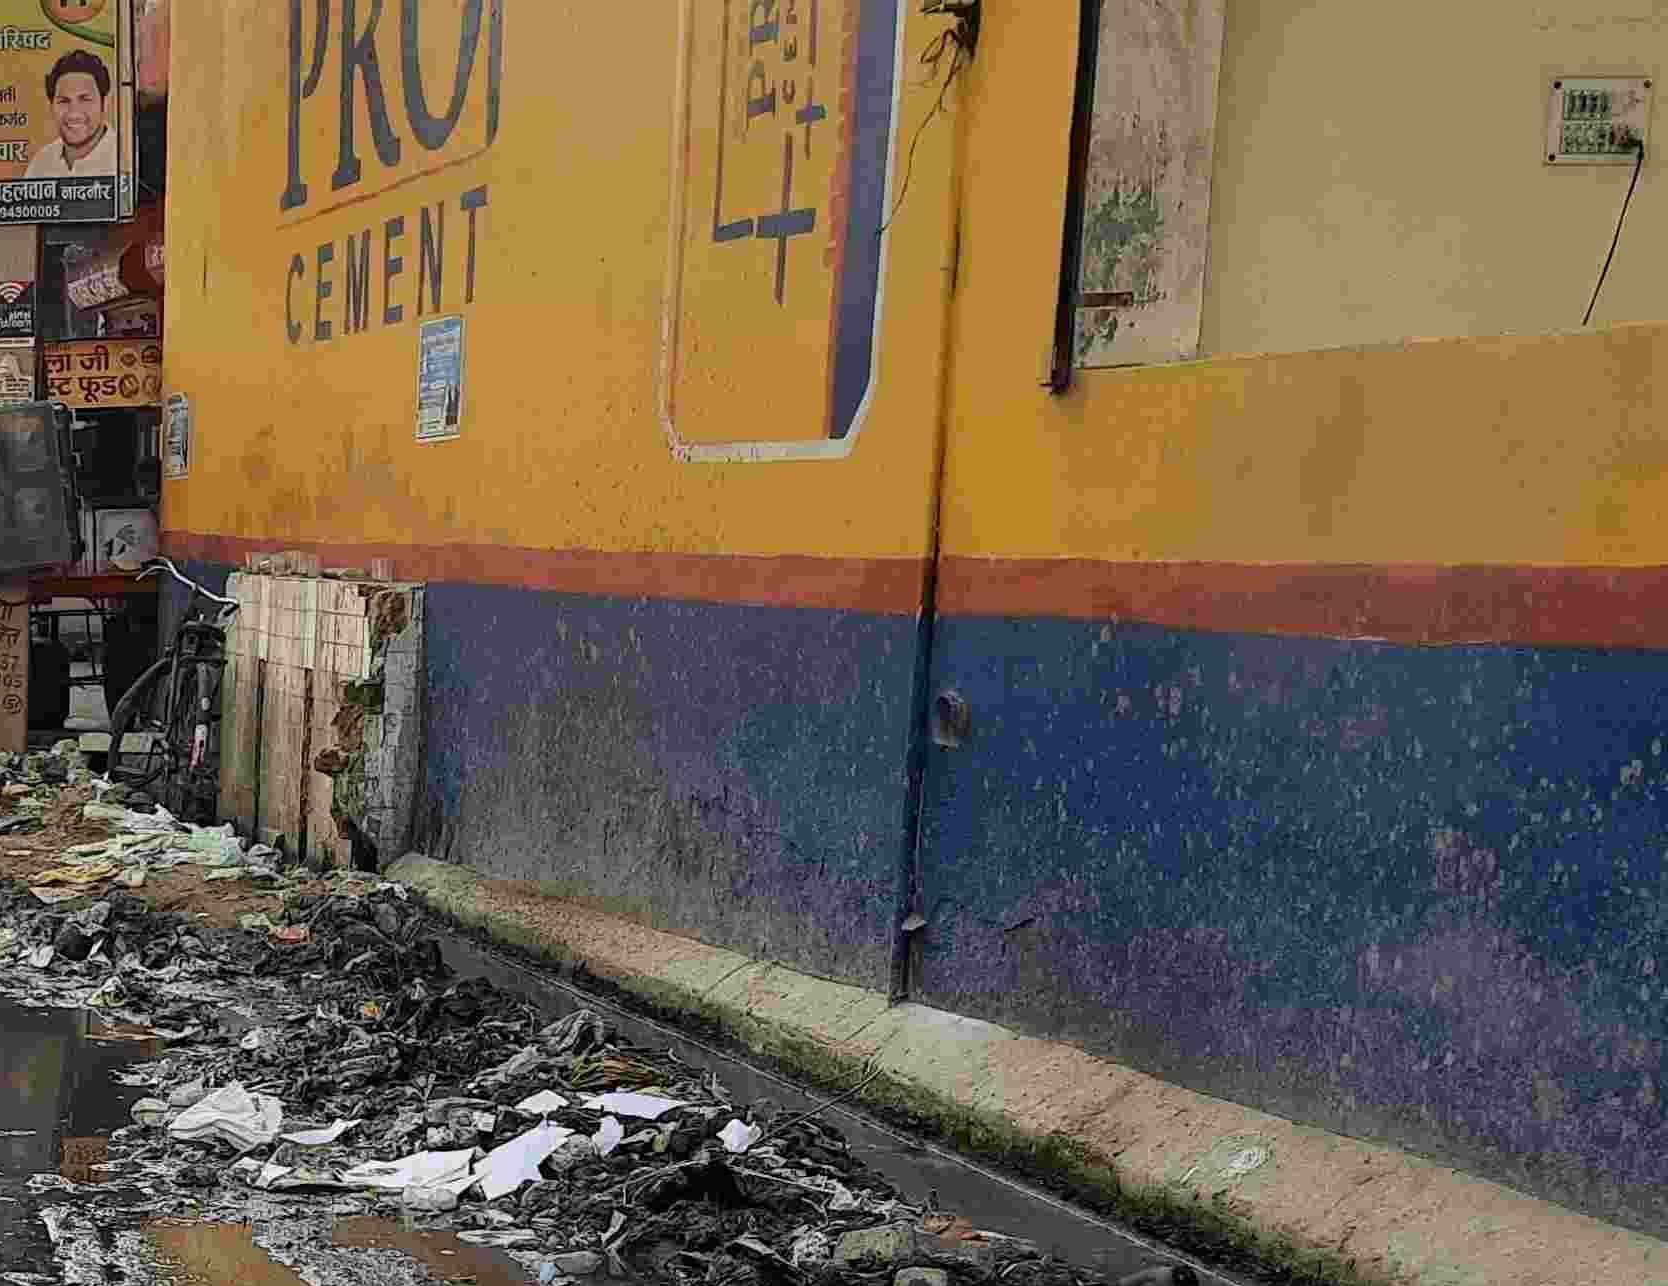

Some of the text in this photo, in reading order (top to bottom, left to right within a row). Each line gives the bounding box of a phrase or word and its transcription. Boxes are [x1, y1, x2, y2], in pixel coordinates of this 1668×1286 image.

[285, 184, 489, 344] CEMENT
[80, 344, 109, 373] जी
[79, 375, 118, 402] फूड
